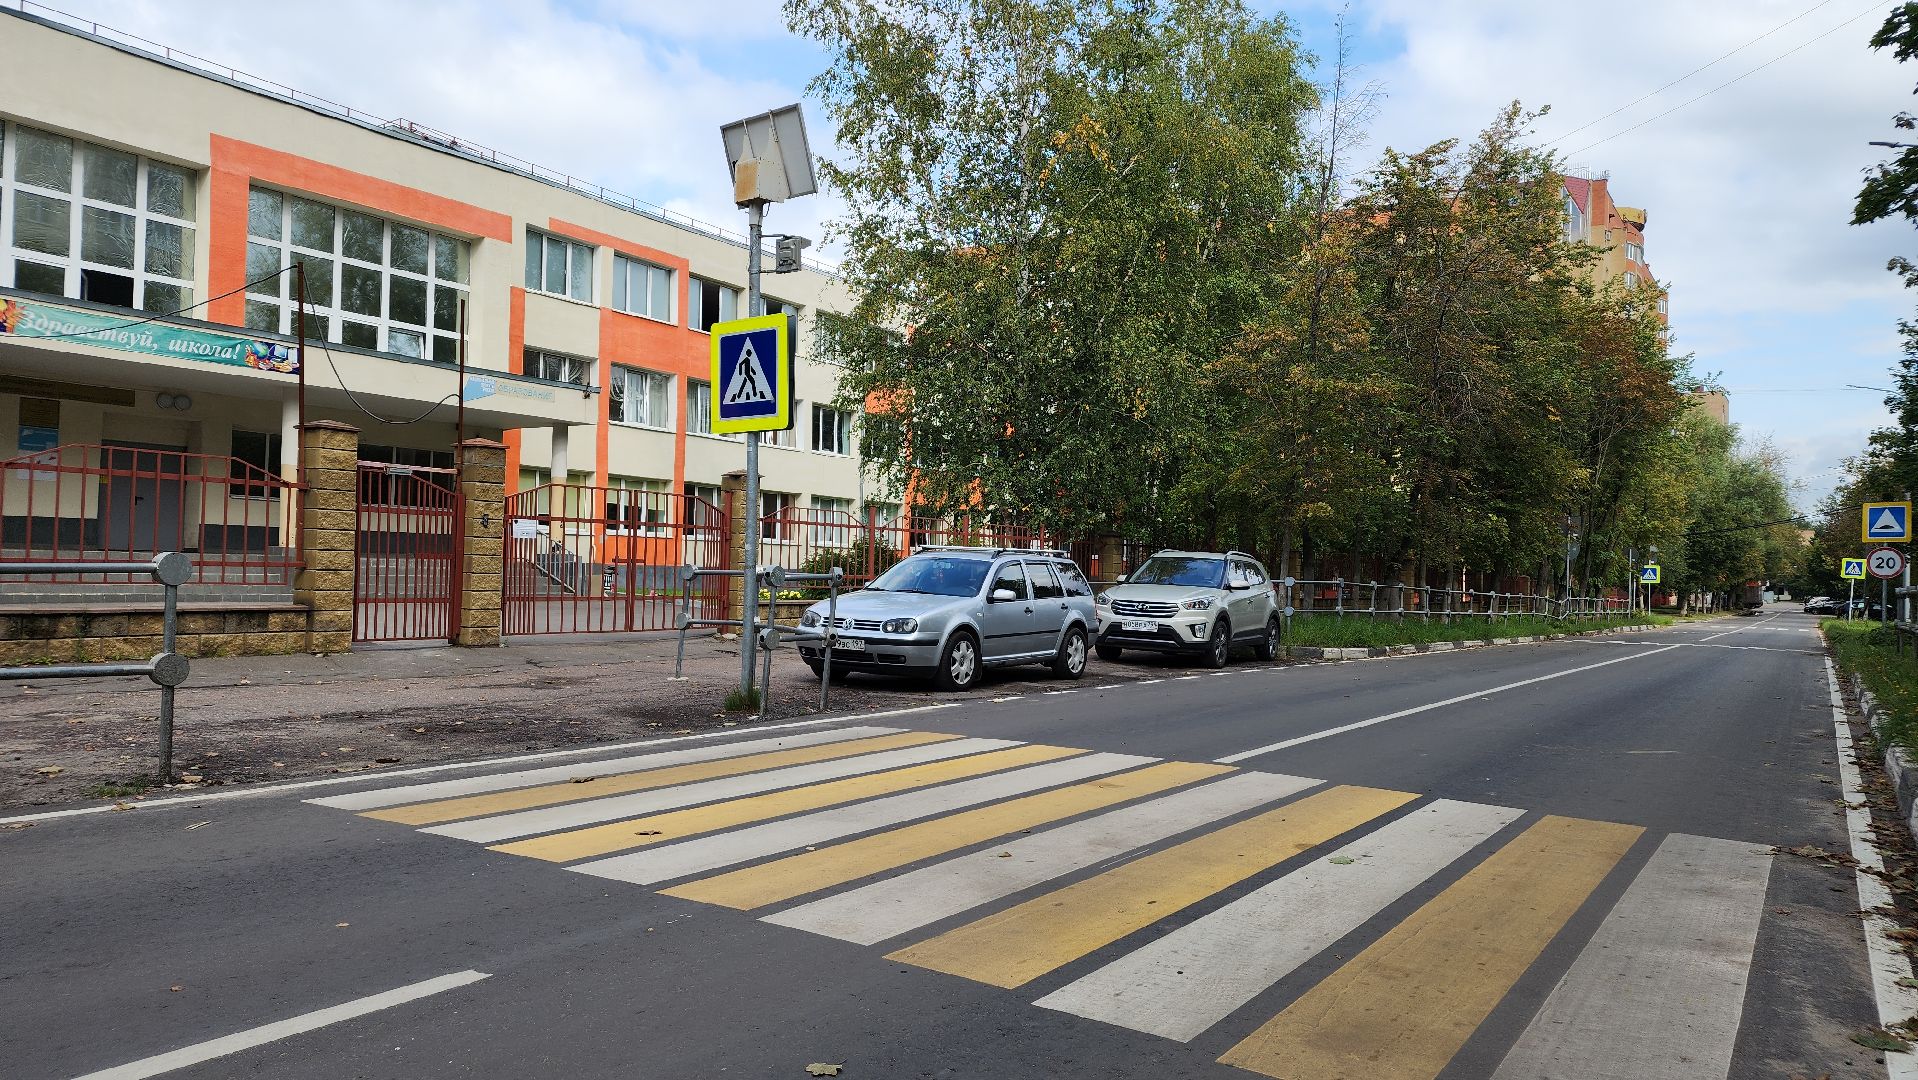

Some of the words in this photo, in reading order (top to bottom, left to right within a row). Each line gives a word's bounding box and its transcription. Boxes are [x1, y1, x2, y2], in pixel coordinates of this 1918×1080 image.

[18, 309, 158, 349] Здравствуй,
[168, 339, 240, 359] школа!
[1875, 556, 1896, 568] 20
